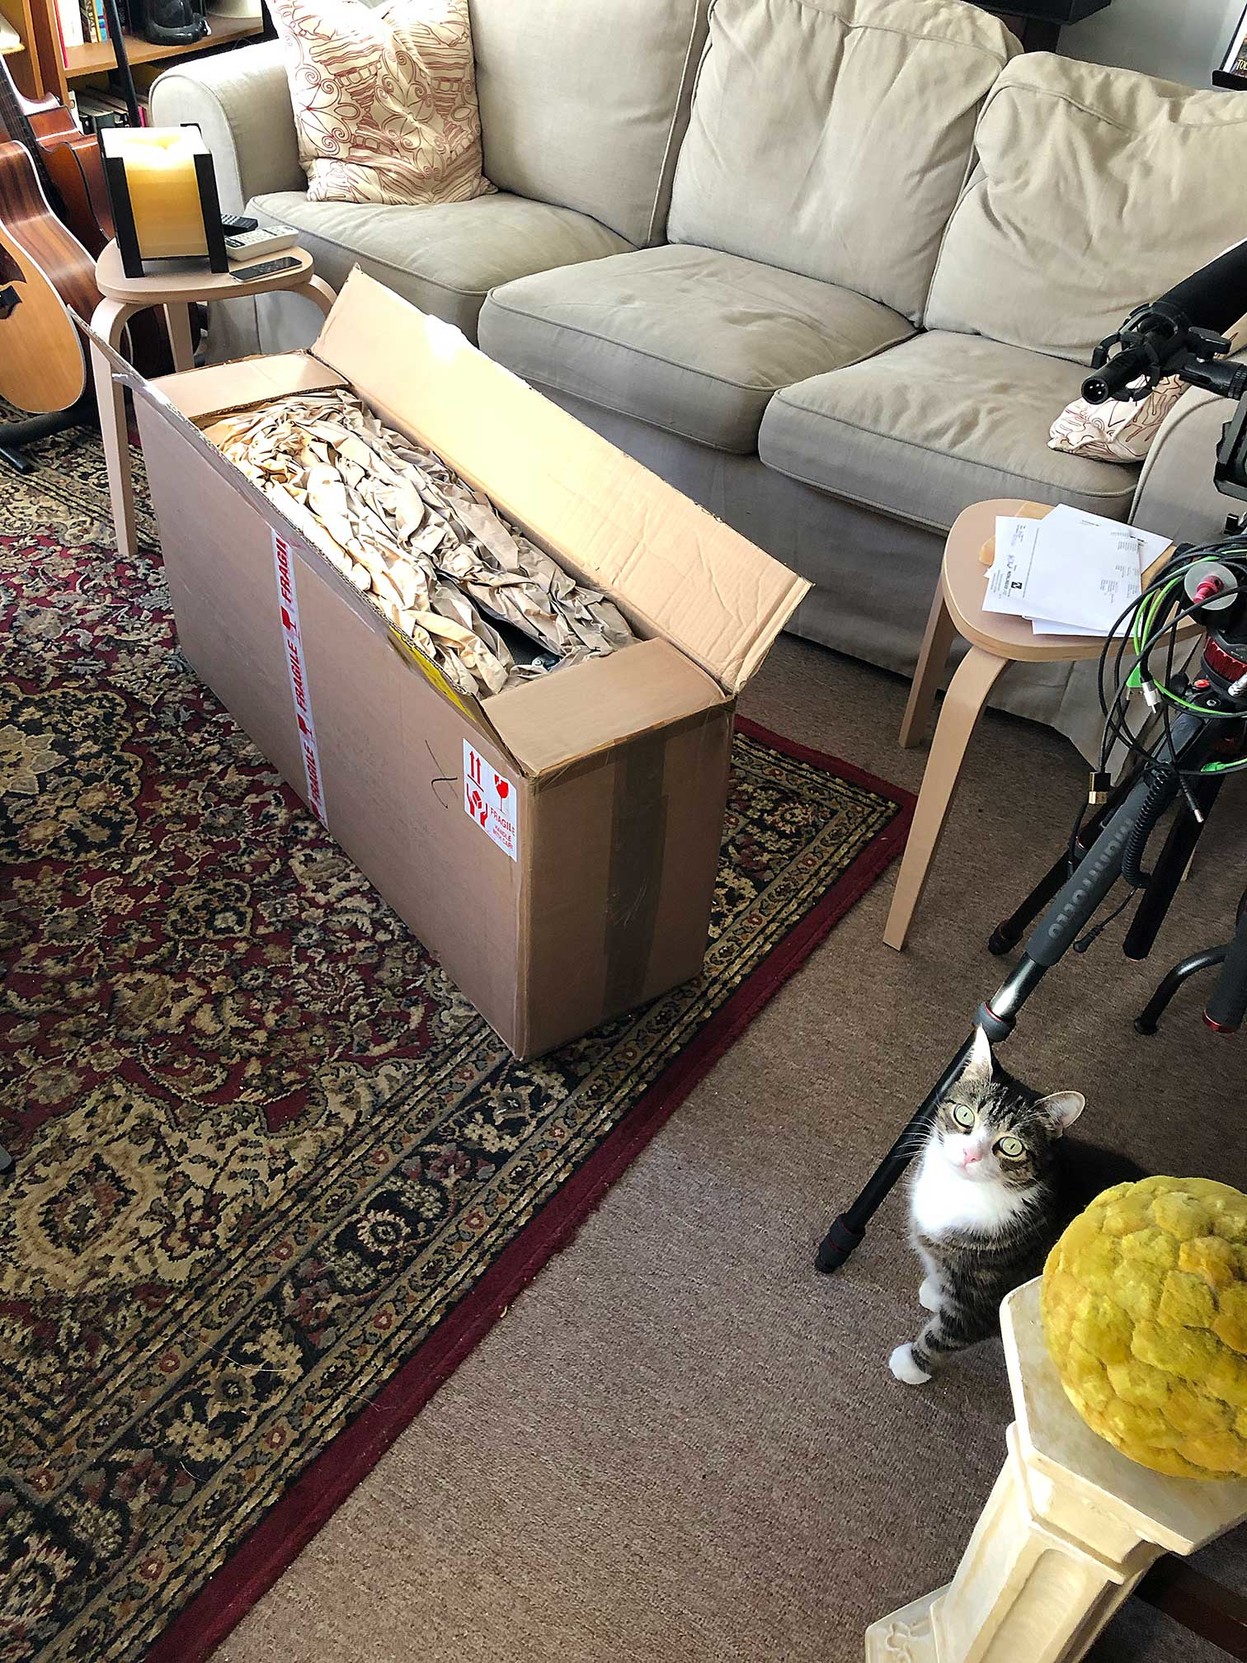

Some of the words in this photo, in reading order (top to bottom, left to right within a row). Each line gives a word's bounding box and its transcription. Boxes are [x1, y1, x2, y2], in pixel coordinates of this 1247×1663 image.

[287, 639, 307, 712] FRAGILE
[304, 742, 321, 801] FRAGILE
[490, 807, 515, 836] FRAGILE
